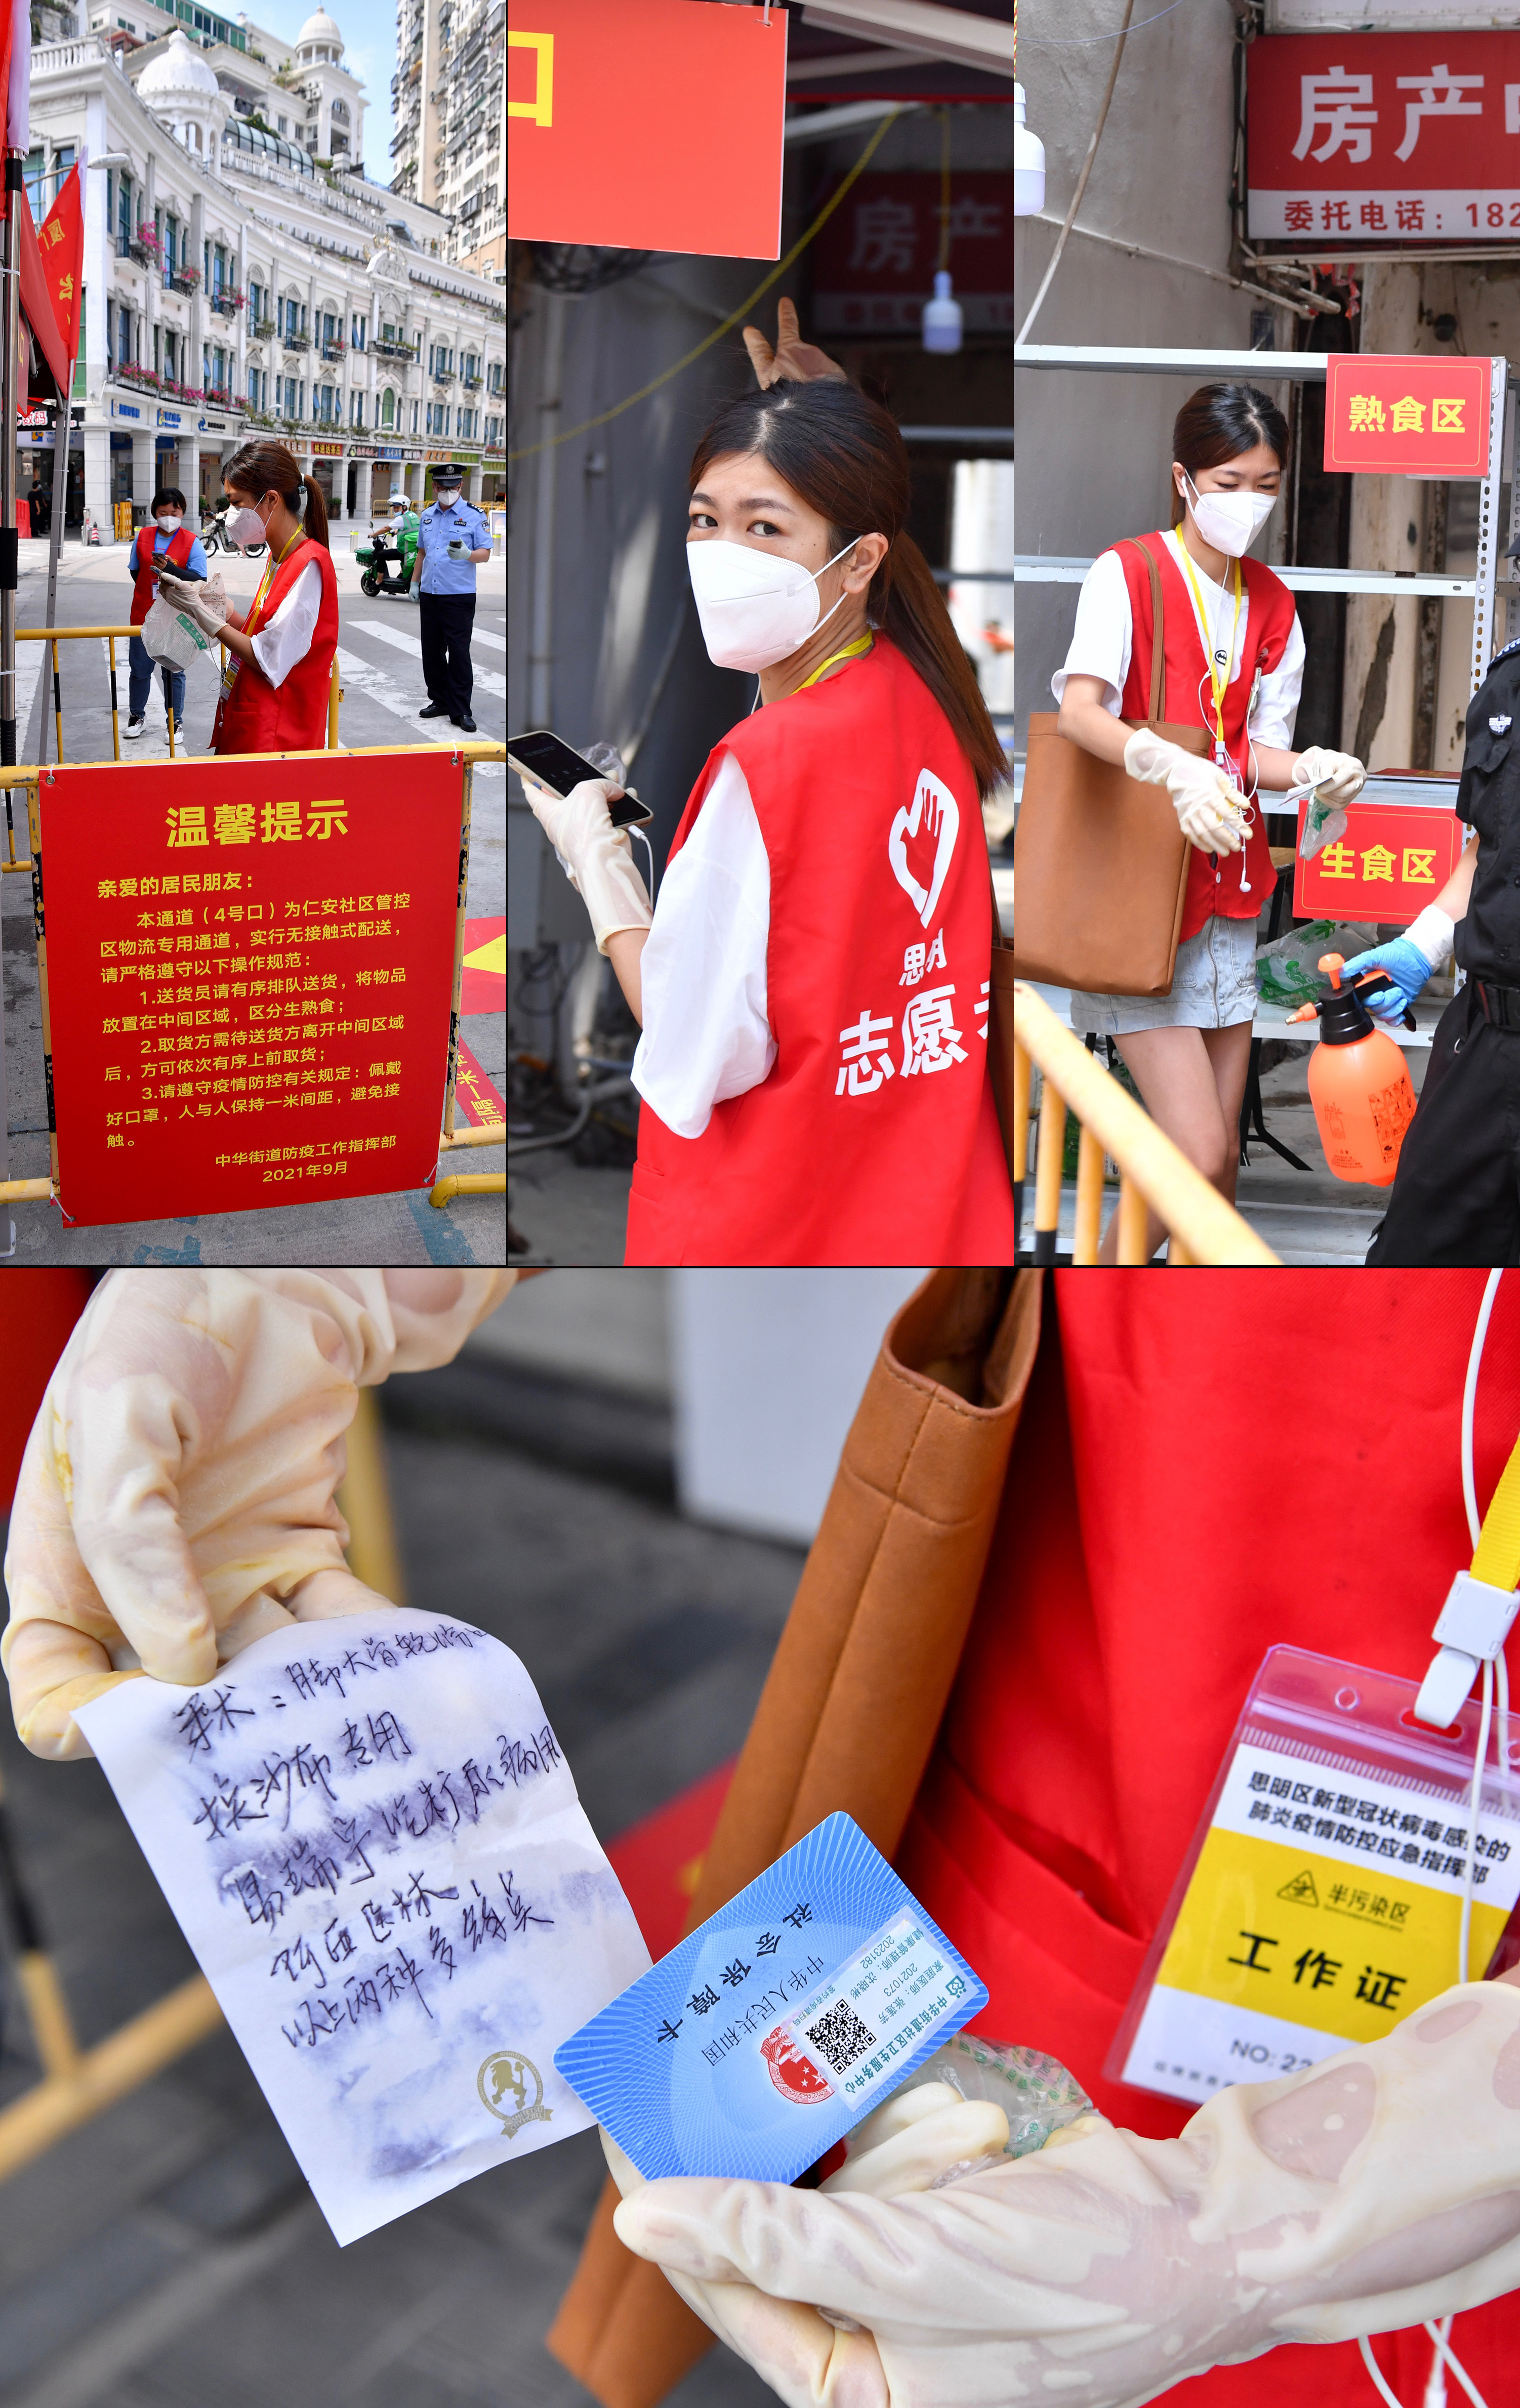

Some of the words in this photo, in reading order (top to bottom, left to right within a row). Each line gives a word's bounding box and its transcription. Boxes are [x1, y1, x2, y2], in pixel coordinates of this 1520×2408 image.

[1285, 200, 1444, 231] 委托电话：
[1348, 395, 1466, 434] 熟食区
[166, 800, 348, 847] 温馨提示
[1320, 842, 1436, 884] 生食区
[98, 872, 252, 898] 亲爱的居民朋友：
[137, 893, 409, 928] 本通道（4号口）为仁安社区管控
[101, 919, 400, 957] 区物流专用通道，实行无接触式配送，
[101, 952, 310, 982] 请严格遵守以下操作规范：
[140, 968, 405, 1004] 1.送货员请有序排队送货，将物品
[103, 999, 343, 1033] 放置在中间区域，区分生熟食；
[141, 1015, 404, 1053] 2.取货方需待送货方离开中间区域
[105, 1047, 324, 1081] 后，方可依次有序上前取货；
[142, 1061, 401, 1099] 3.请遵守疫情防控有关规定：佩戴
[107, 1083, 399, 1126] 好口罩，人与人保持一米间距，避免接
[107, 1134, 136, 1148] 触。
[216, 1136, 396, 1167] 中华街道防疫工作指挥部
[263, 1161, 347, 1182] 2021年9月
[1327, 1883, 1411, 1924] 半污染区
[860, 1935, 894, 1969] 2023182
[656, 1902, 813, 2044] 社会保障卡
[883, 1963, 918, 1997] 2021073
[905, 1960, 944, 2000] 家庭医师：
[1227, 1931, 1407, 2012] 工作证
[702, 1955, 825, 2067] 中华人民共和国
[845, 1996, 950, 2093] 中华街道社区卫生服务中心
[482, 2056, 495, 2070] HOTEL
[500, 2051, 528, 2064] NISHITETSU
[529, 2064, 540, 2081] GRAND
[506, 2107, 543, 2127] NISHITETSU
[523, 2112, 542, 2123] HOTEL
